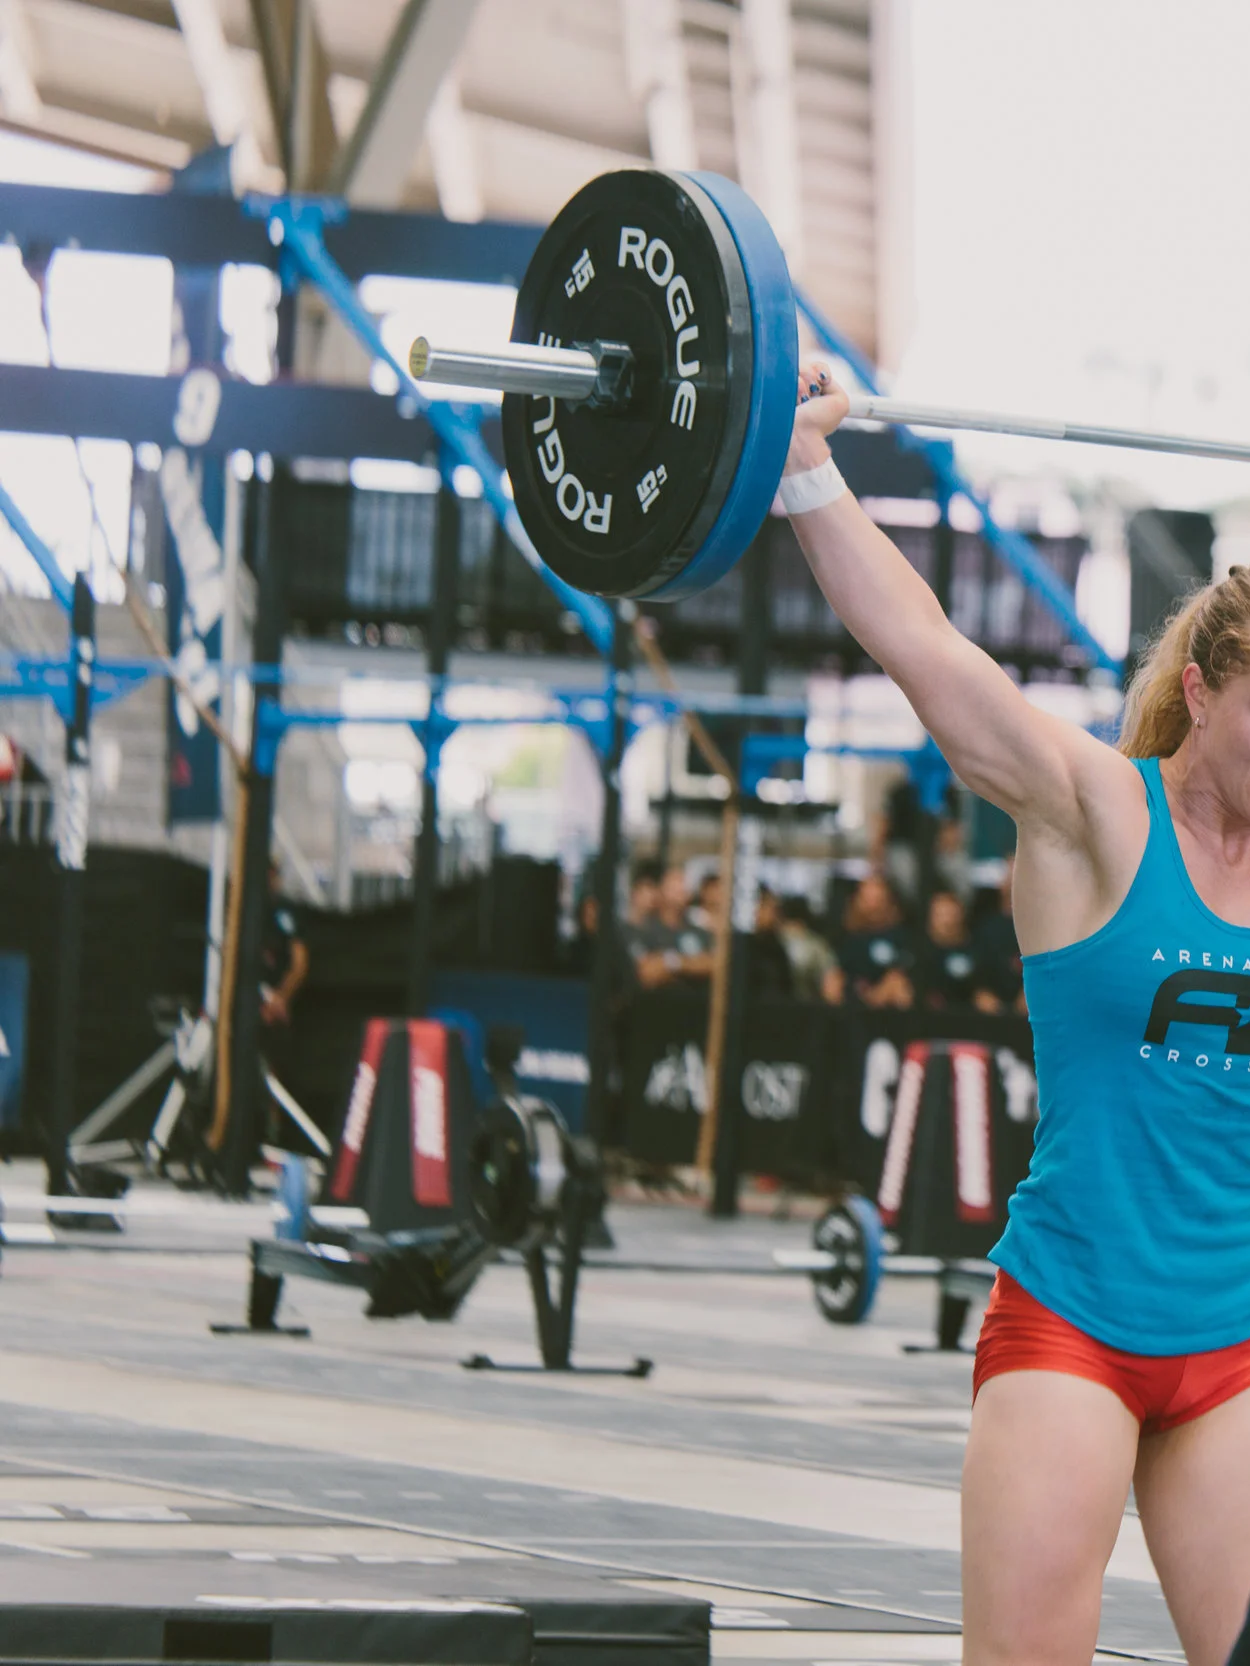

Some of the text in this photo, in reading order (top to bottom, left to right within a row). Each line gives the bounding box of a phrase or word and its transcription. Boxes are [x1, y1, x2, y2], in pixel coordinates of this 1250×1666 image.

[571, 248, 595, 292] 15
[617, 226, 699, 431] ROGUE
[636, 470, 661, 514] 15
